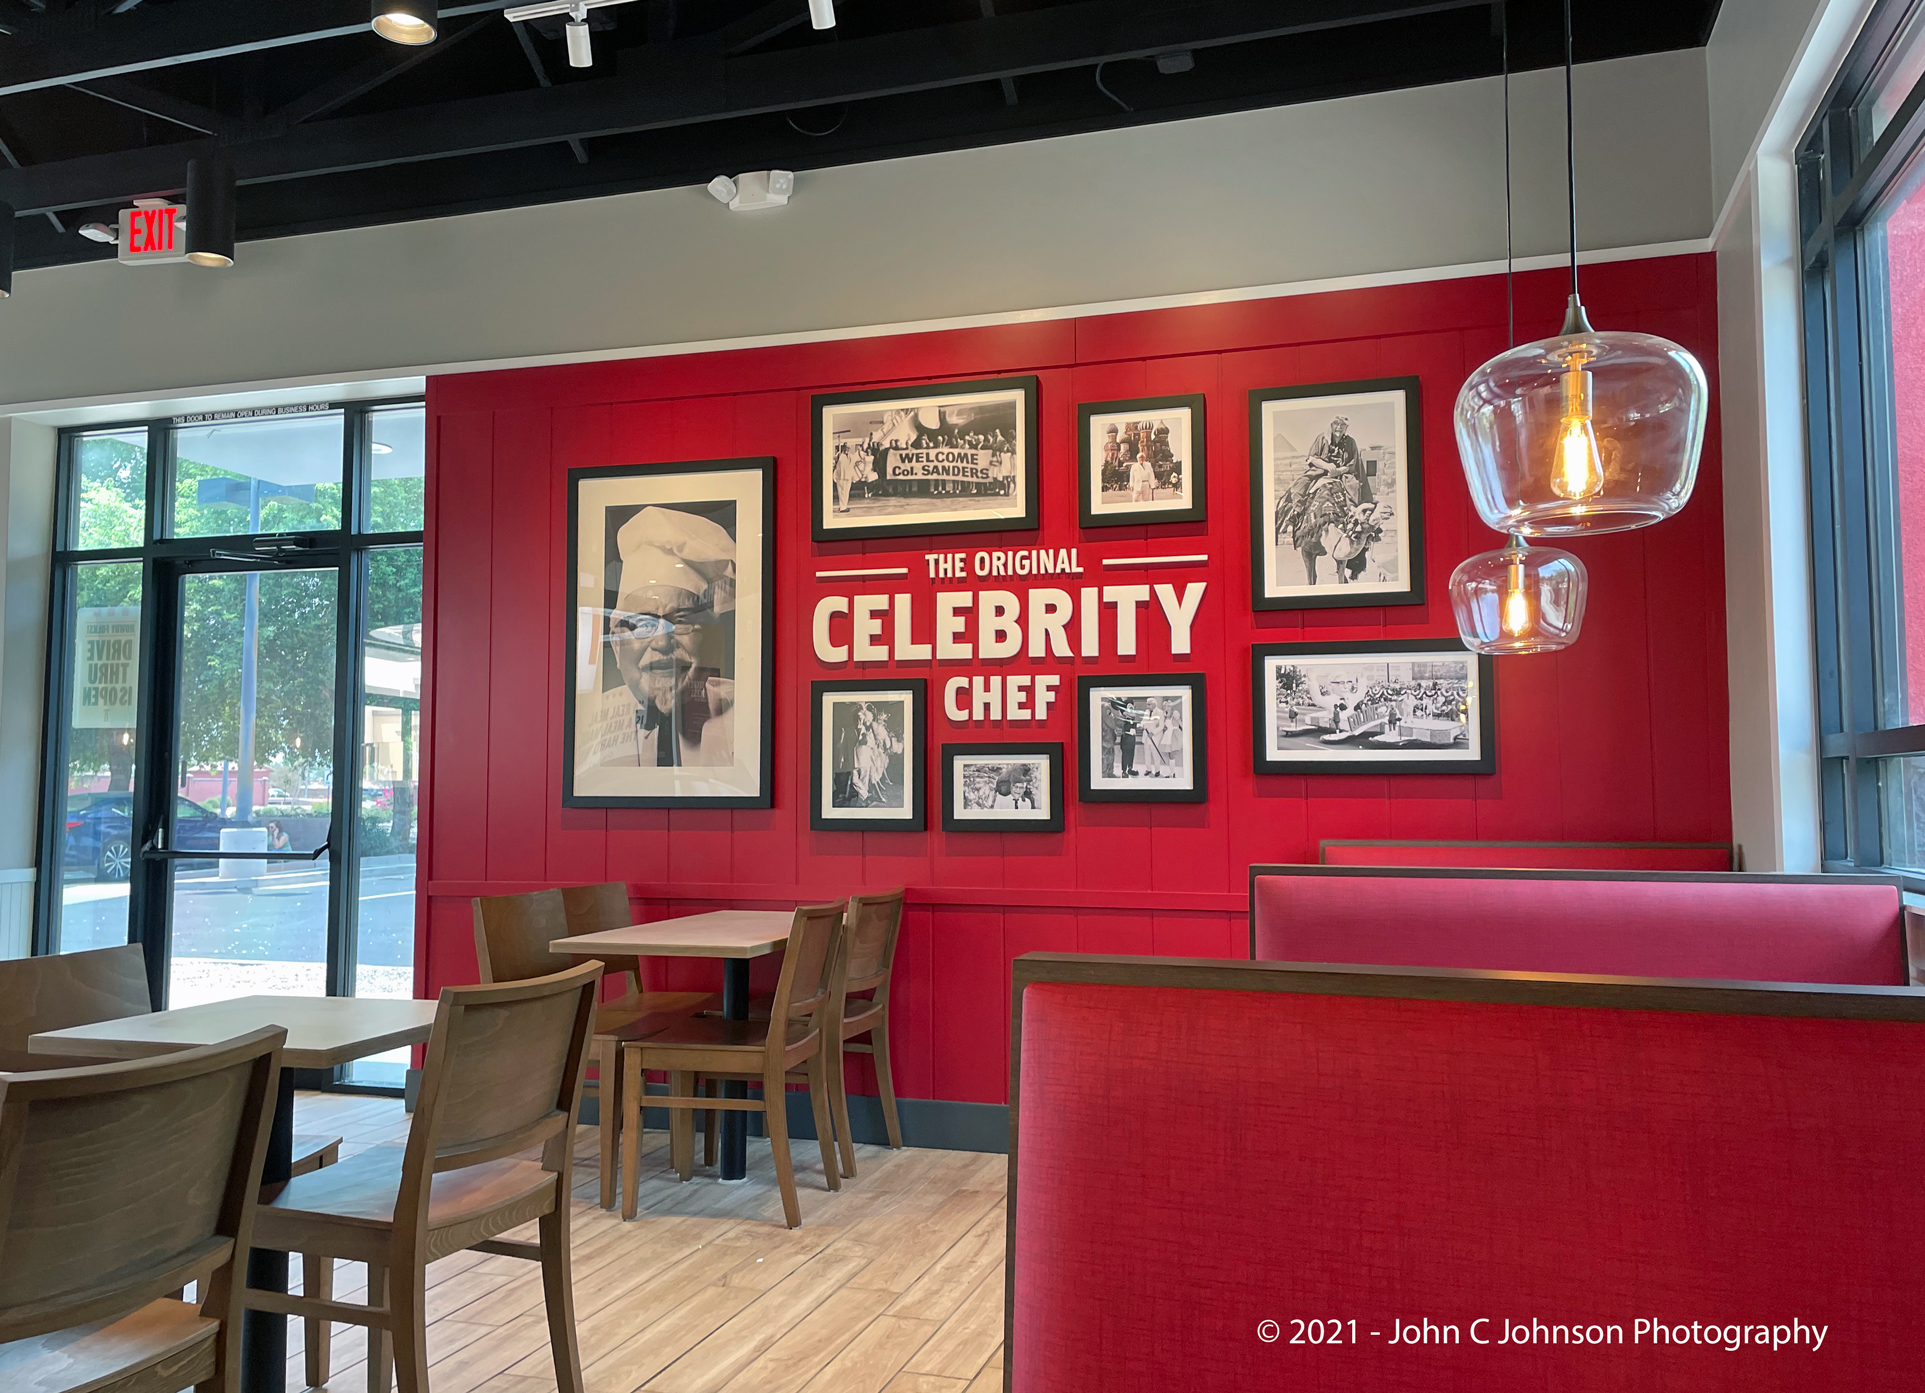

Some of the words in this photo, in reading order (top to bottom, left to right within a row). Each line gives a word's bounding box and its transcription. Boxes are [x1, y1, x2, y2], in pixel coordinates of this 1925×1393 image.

[129, 207, 178, 253] EXIT
[187, 415, 203, 423] DOOR
[214, 412, 236, 420] REMAIN
[237, 410, 252, 418] OPEN
[254, 407, 276, 417] DURING
[277, 405, 307, 414] BUSINESS
[309, 403, 329, 412] HOURS
[892, 466, 918, 476] Col.
[921, 465, 990, 479] SANDERS
[899, 452, 979, 465] WELCOME
[925, 553, 967, 578] THE
[974, 548, 1084, 576] ORIGINAL
[812, 582, 1207, 663] CELEBRITY
[944, 674, 1061, 721] CHEF
